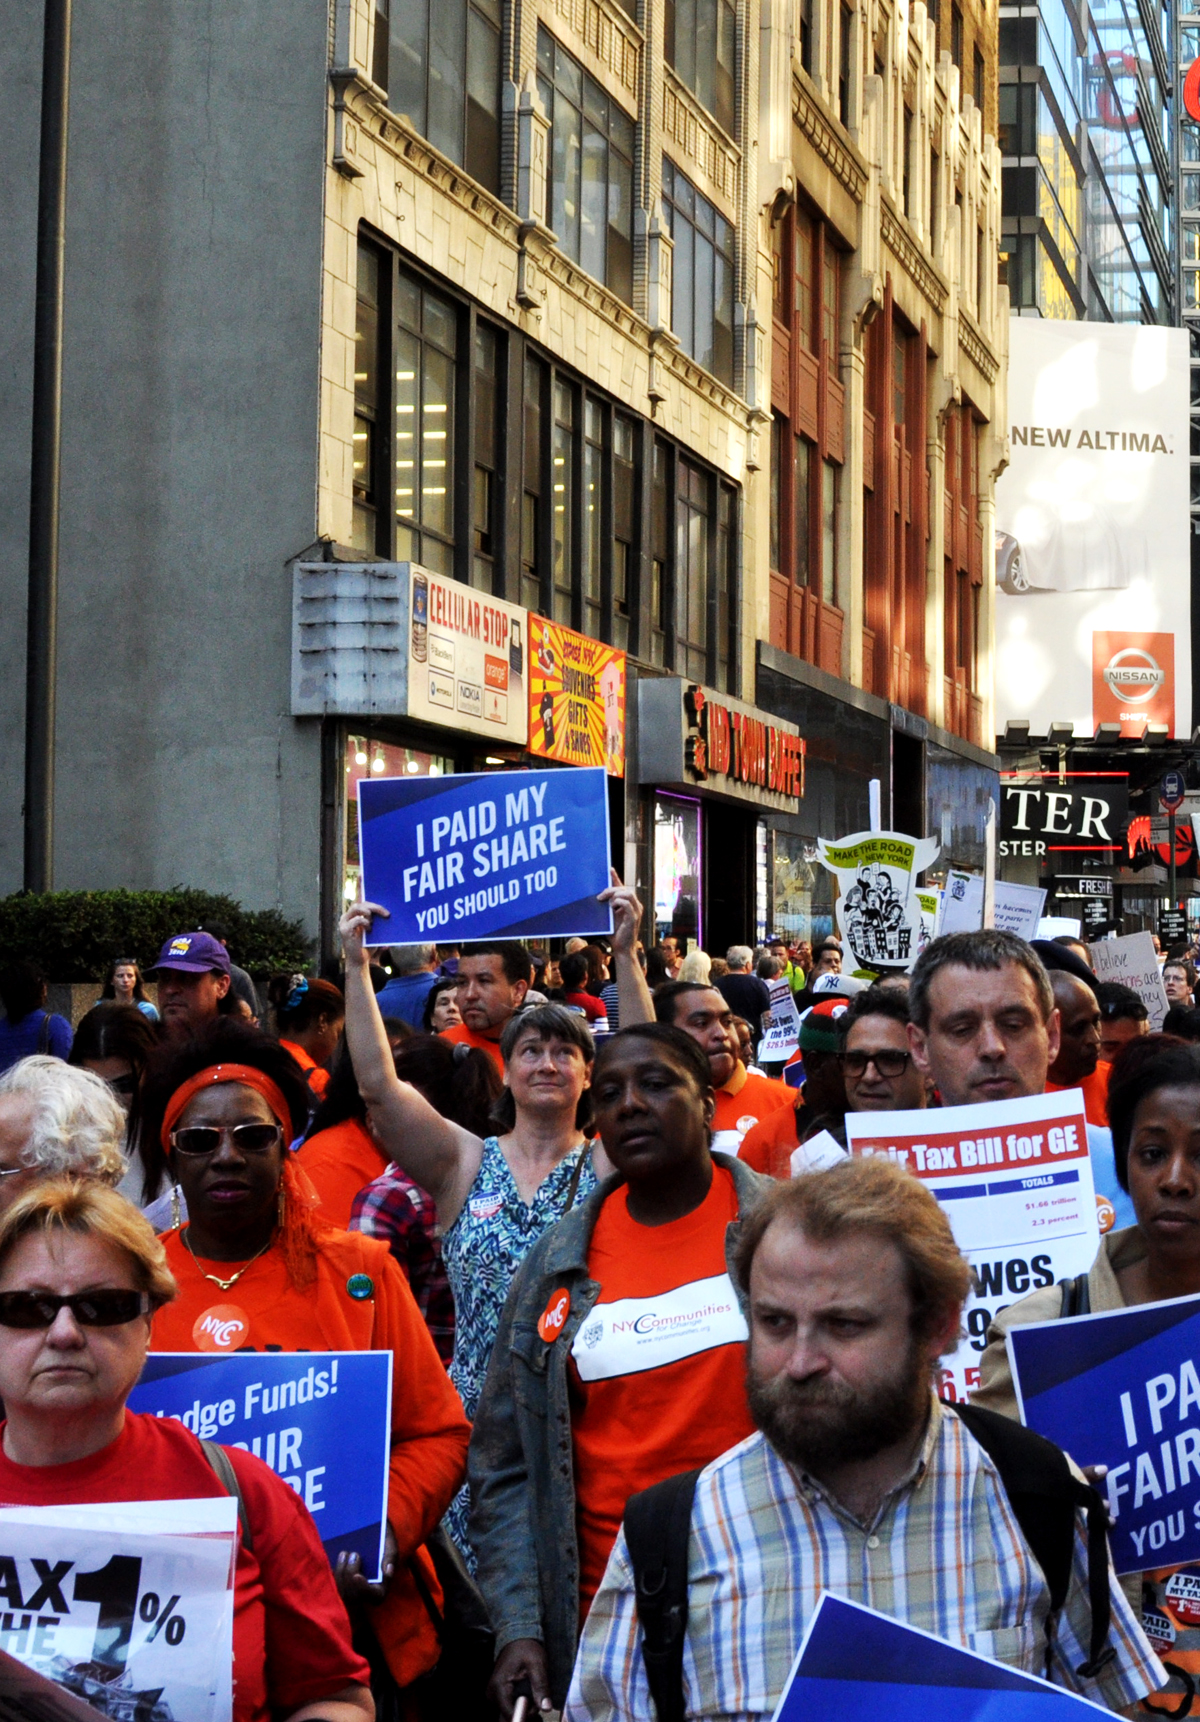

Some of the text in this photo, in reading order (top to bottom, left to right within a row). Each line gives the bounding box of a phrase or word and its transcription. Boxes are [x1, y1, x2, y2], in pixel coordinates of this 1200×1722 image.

[1076, 430, 1174, 454] ALTIMA.
[430, 582, 509, 649] CELLULAR STOP
[1109, 671, 1159, 681] NISSAN
[460, 685, 480, 701] NOKIA
[568, 698, 588, 729] GIFTS
[416, 781, 548, 857] I PAID MY
[1006, 787, 1112, 841] TER
[834, 841, 912, 861] MAKE THE ROAD
[999, 840, 1046, 856] STER
[403, 815, 567, 903] FAIR SHARE
[865, 853, 909, 866] NEW YORK
[1079, 880, 1107, 894] FRESH
[415, 865, 558, 933] YOU SHOULD TOO
[1002, 904, 1032, 914] hacemos
[1143, 971, 1160, 986] are
[770, 1030, 782, 1039] the
[911, 1124, 1079, 1171] Tax Bill for GE
[1021, 1175, 1054, 1188] TOTALS
[1025, 1196, 1077, 1210] $1.66 trillion
[1032, 1213, 1079, 1227] 2.3 percent
[972, 1254, 1055, 1299] wes
[244, 1359, 339, 1420] Funds!
[1120, 1391, 1138, 1448] I
[1129, 1509, 1186, 1557] YOU
[1174, 1575, 1180, 1586] I
[1170, 1587, 1185, 1595] MY
[0, 1612, 61, 1656] HE
